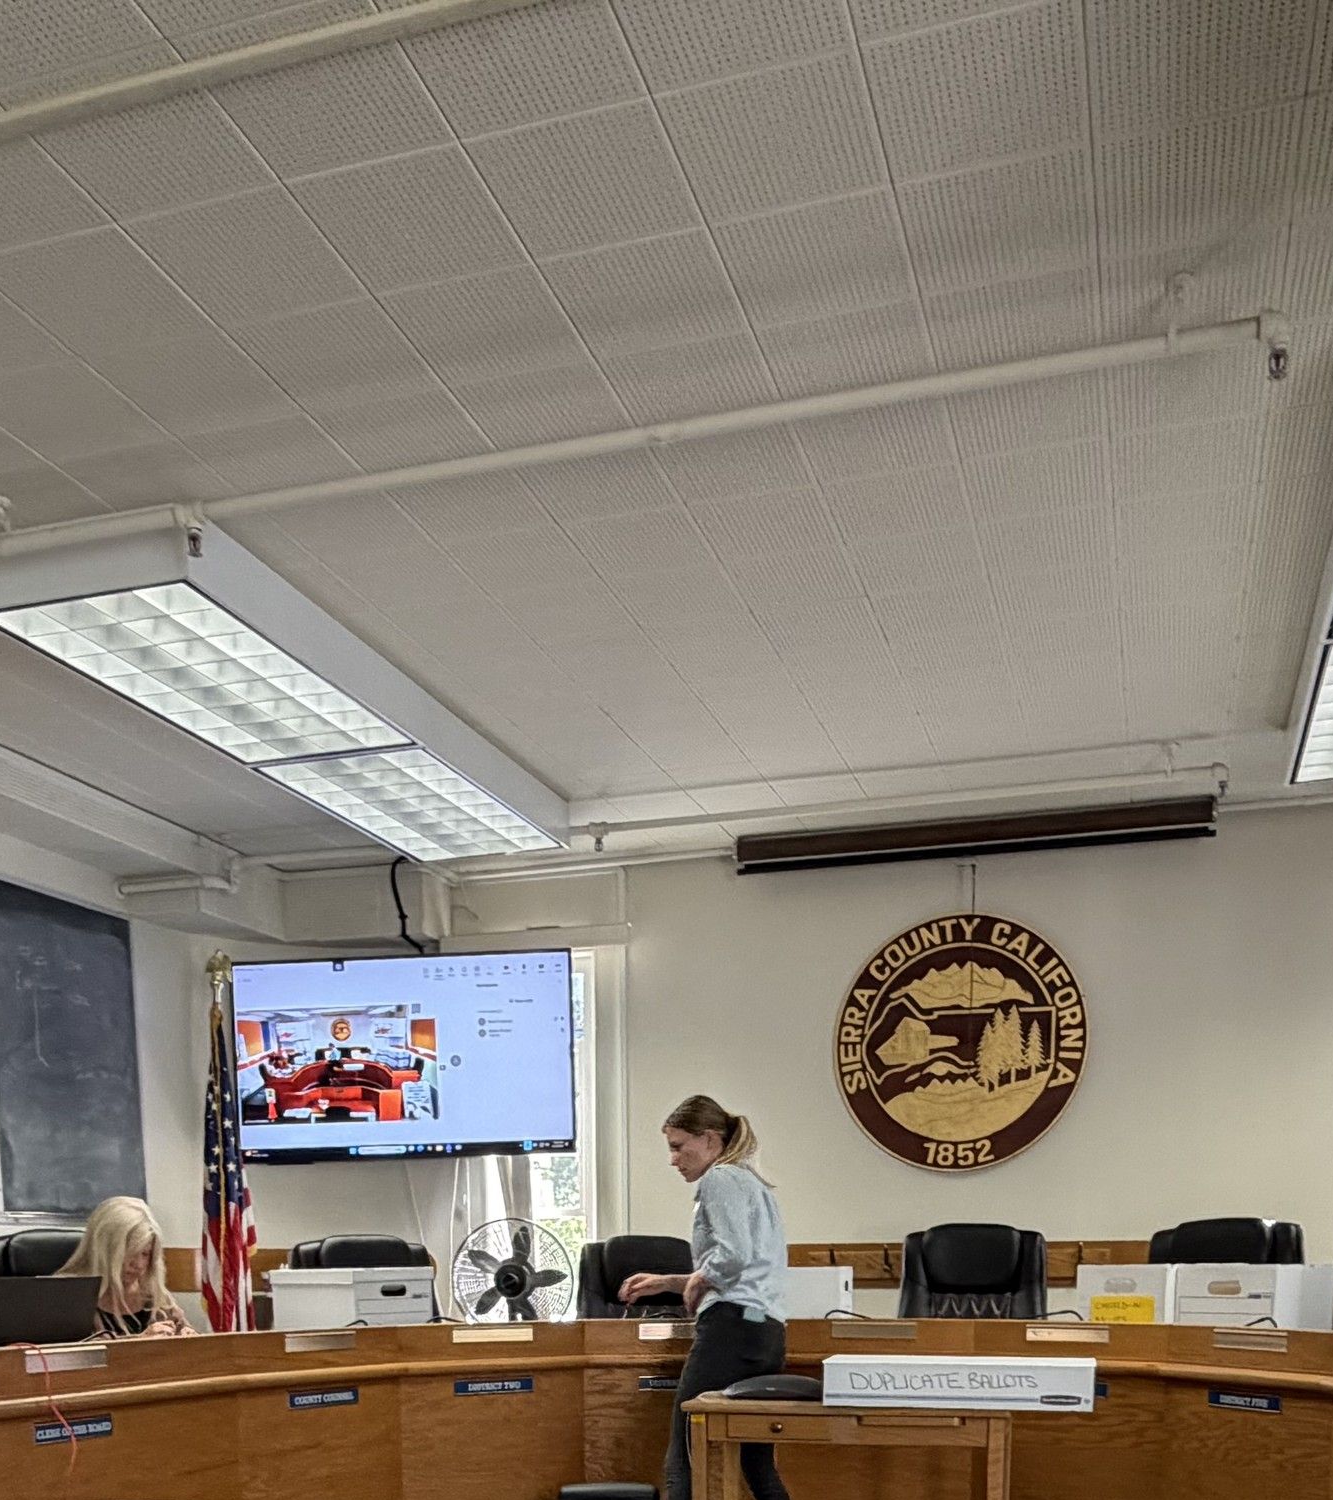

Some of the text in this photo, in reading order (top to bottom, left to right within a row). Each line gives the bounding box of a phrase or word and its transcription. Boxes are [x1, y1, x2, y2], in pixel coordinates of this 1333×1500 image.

[839, 918, 1084, 1095] SIERRA COUNTY CALIFORNIA
[923, 1139, 995, 1166] 1852
[467, 1380, 522, 1392] DISTRICT TWO
[849, 1372, 1038, 1390] DUPLICATE BALLOTS
[294, 1391, 355, 1405] COUNTY COUNSEL
[36, 1427, 62, 1440] CLERK
